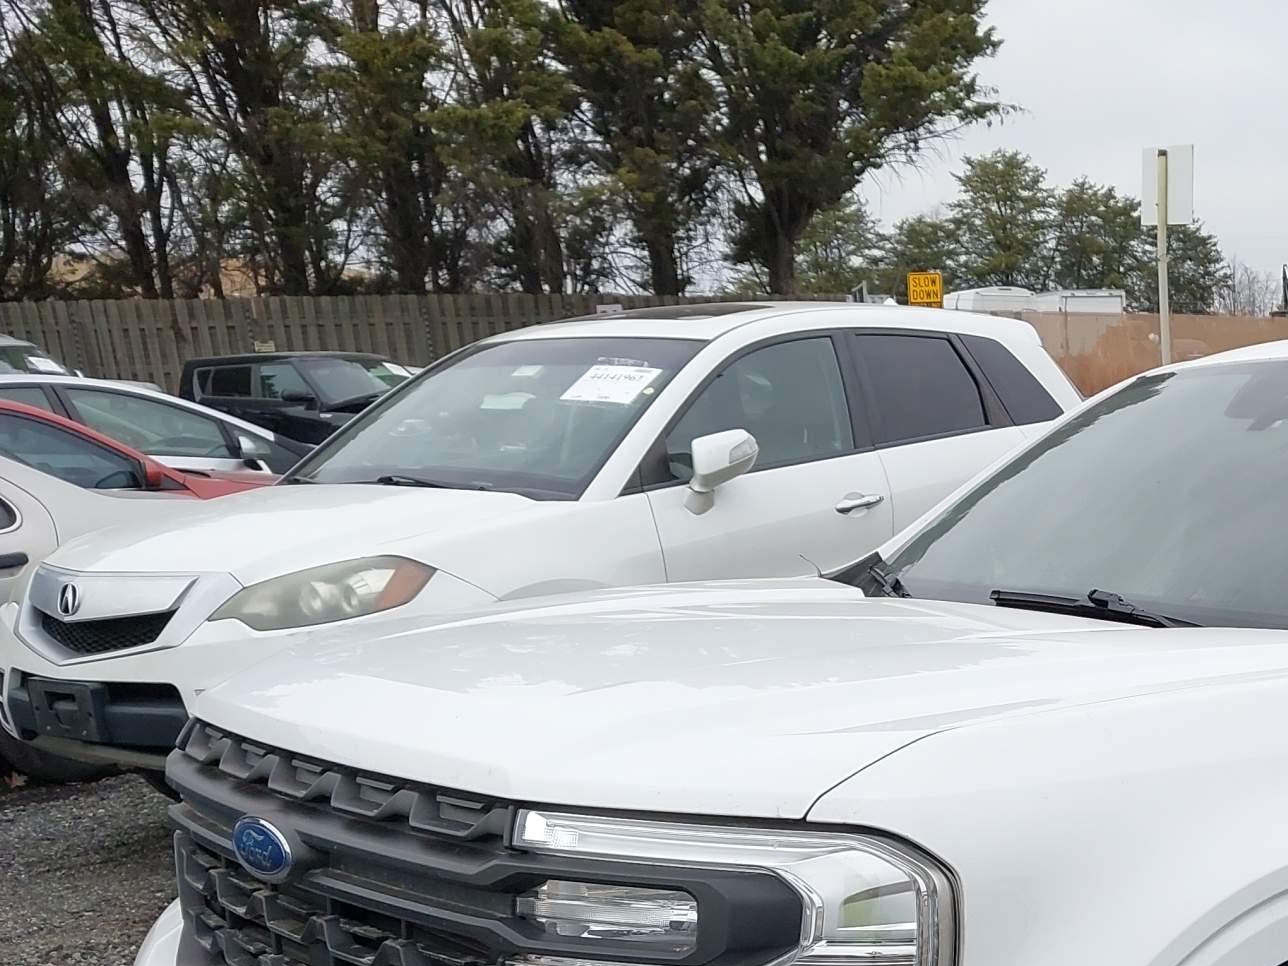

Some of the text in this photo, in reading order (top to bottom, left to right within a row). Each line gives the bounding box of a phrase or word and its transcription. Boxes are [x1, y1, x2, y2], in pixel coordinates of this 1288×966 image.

[911, 276, 937, 288] SLOW
[912, 289, 938, 300] DOWN
[240, 829, 273, 866] Ford
